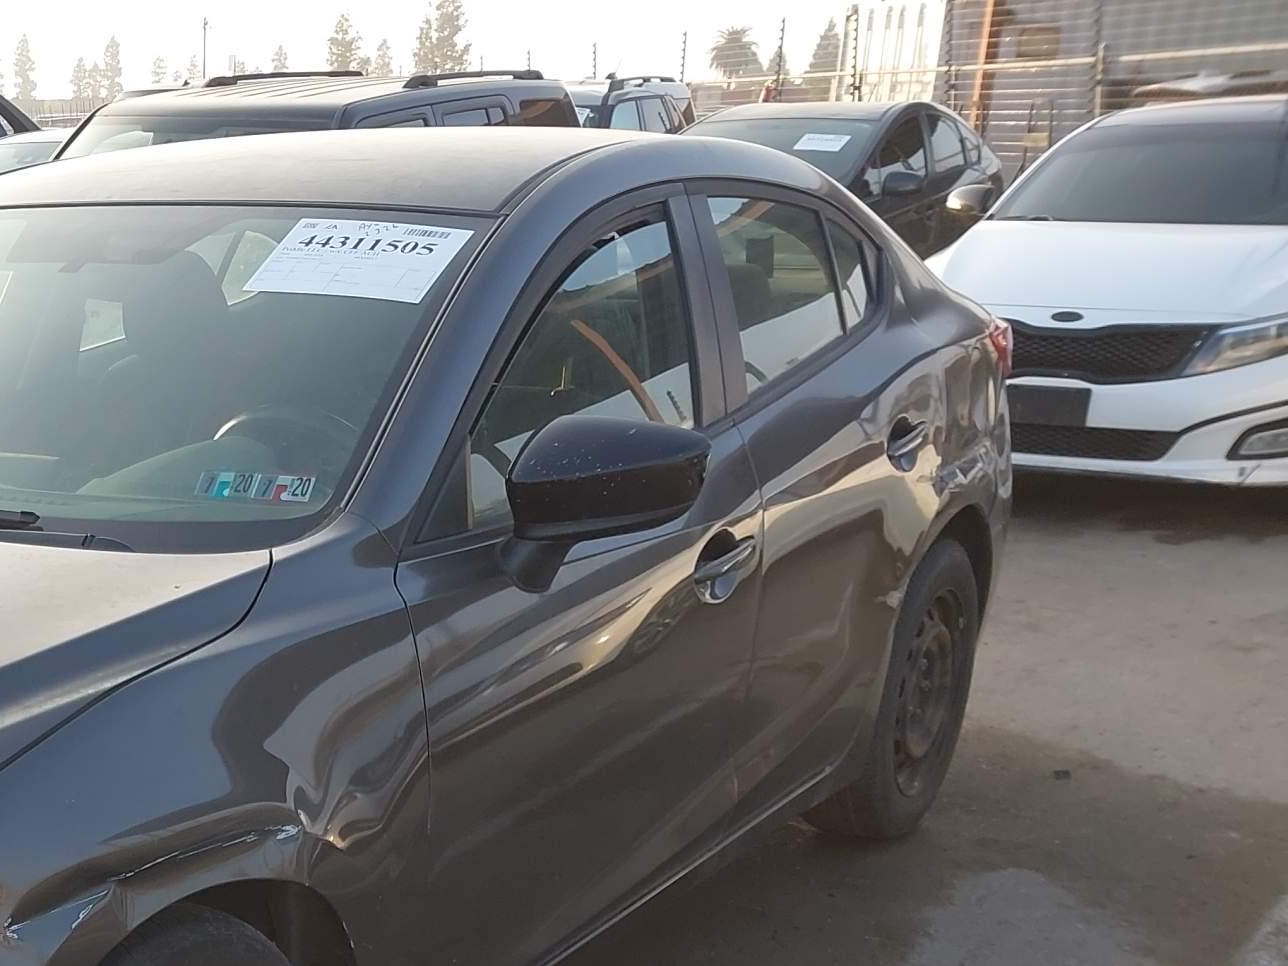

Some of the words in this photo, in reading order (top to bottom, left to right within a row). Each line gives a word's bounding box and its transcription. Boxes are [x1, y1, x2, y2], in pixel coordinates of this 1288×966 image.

[298, 234, 439, 256] 44311505
[234, 474, 254, 493] 20
[291, 477, 312, 497] 20
